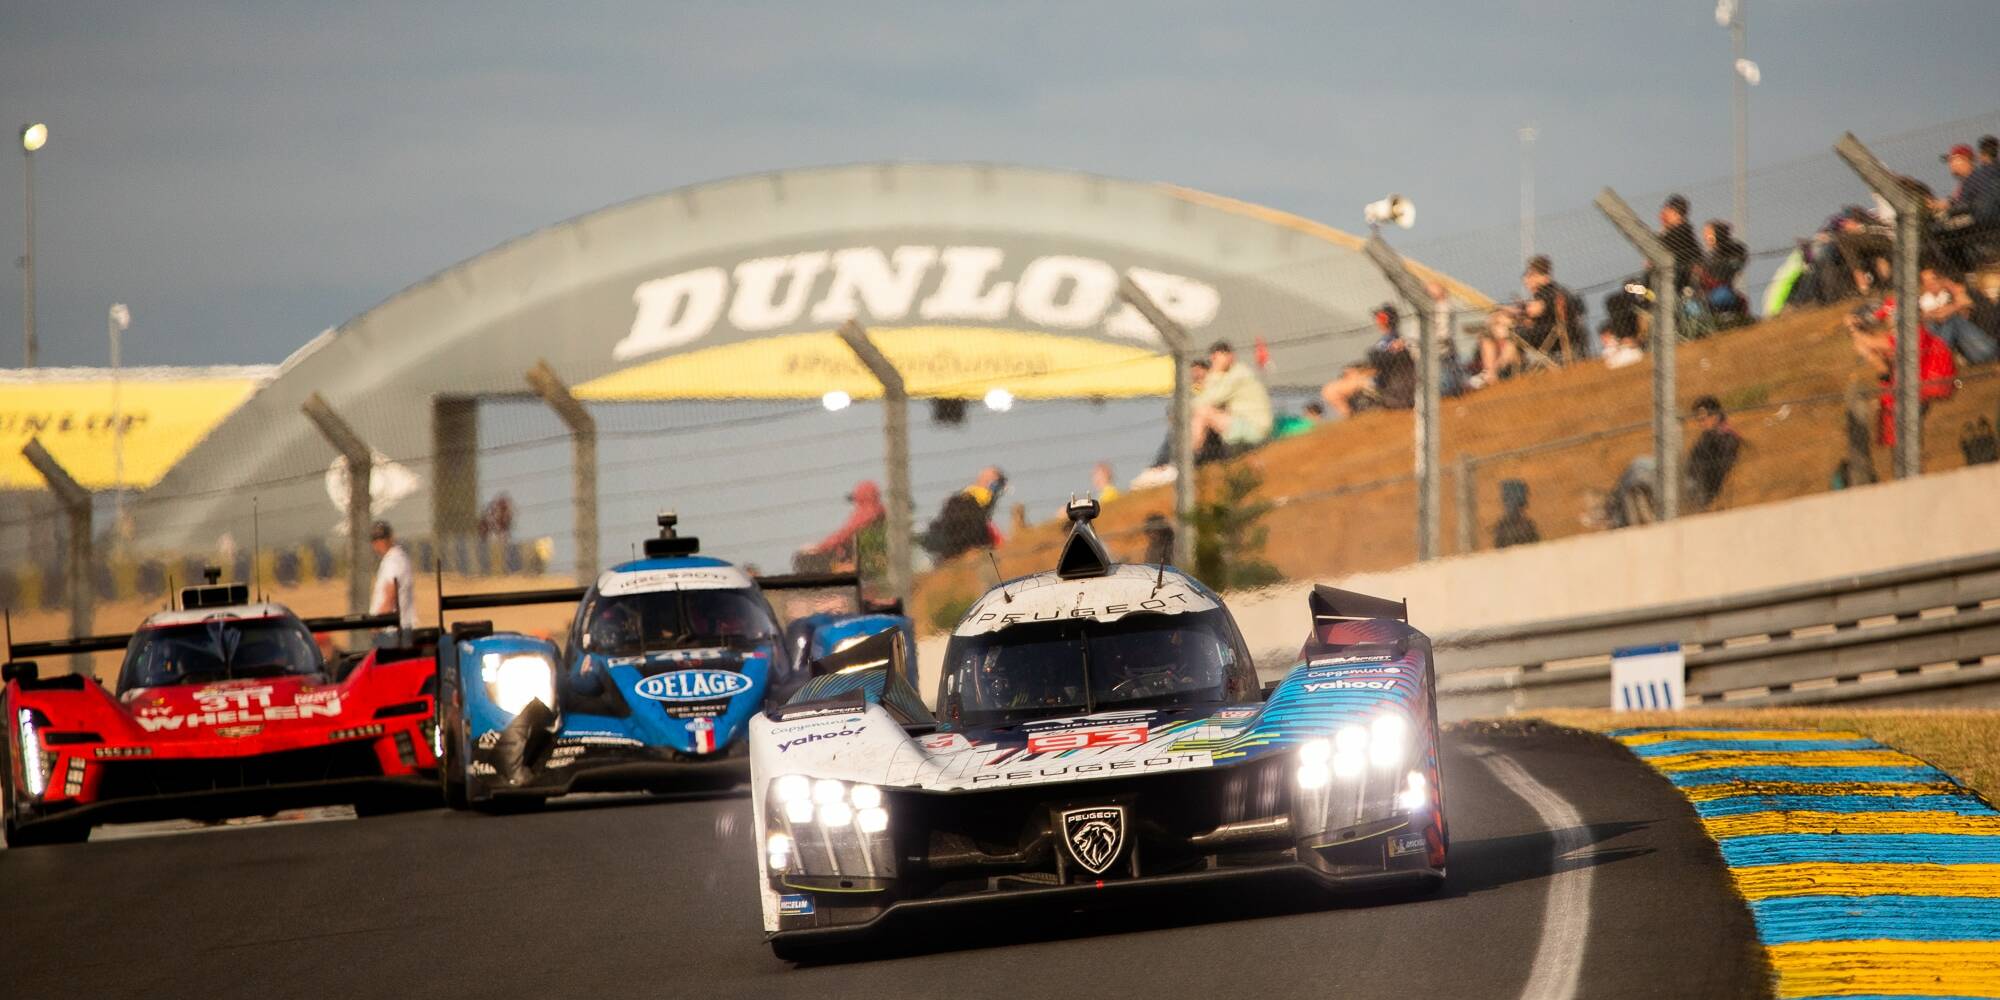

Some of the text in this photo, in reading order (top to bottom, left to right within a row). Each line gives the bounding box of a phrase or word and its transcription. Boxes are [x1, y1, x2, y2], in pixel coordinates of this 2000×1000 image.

[613, 246, 1221, 361] DUNLOP
[976, 593, 1188, 625] PEUGEOT
[647, 673, 739, 697] DELAGE
[1303, 680, 1397, 692] yahoo!
[136, 698, 342, 732] WHELEN
[777, 726, 867, 753] yahoo!
[1034, 729, 1142, 751] 93
[972, 754, 1205, 784] PEUGEOT
[1068, 811, 1118, 823] PEUGEOT
